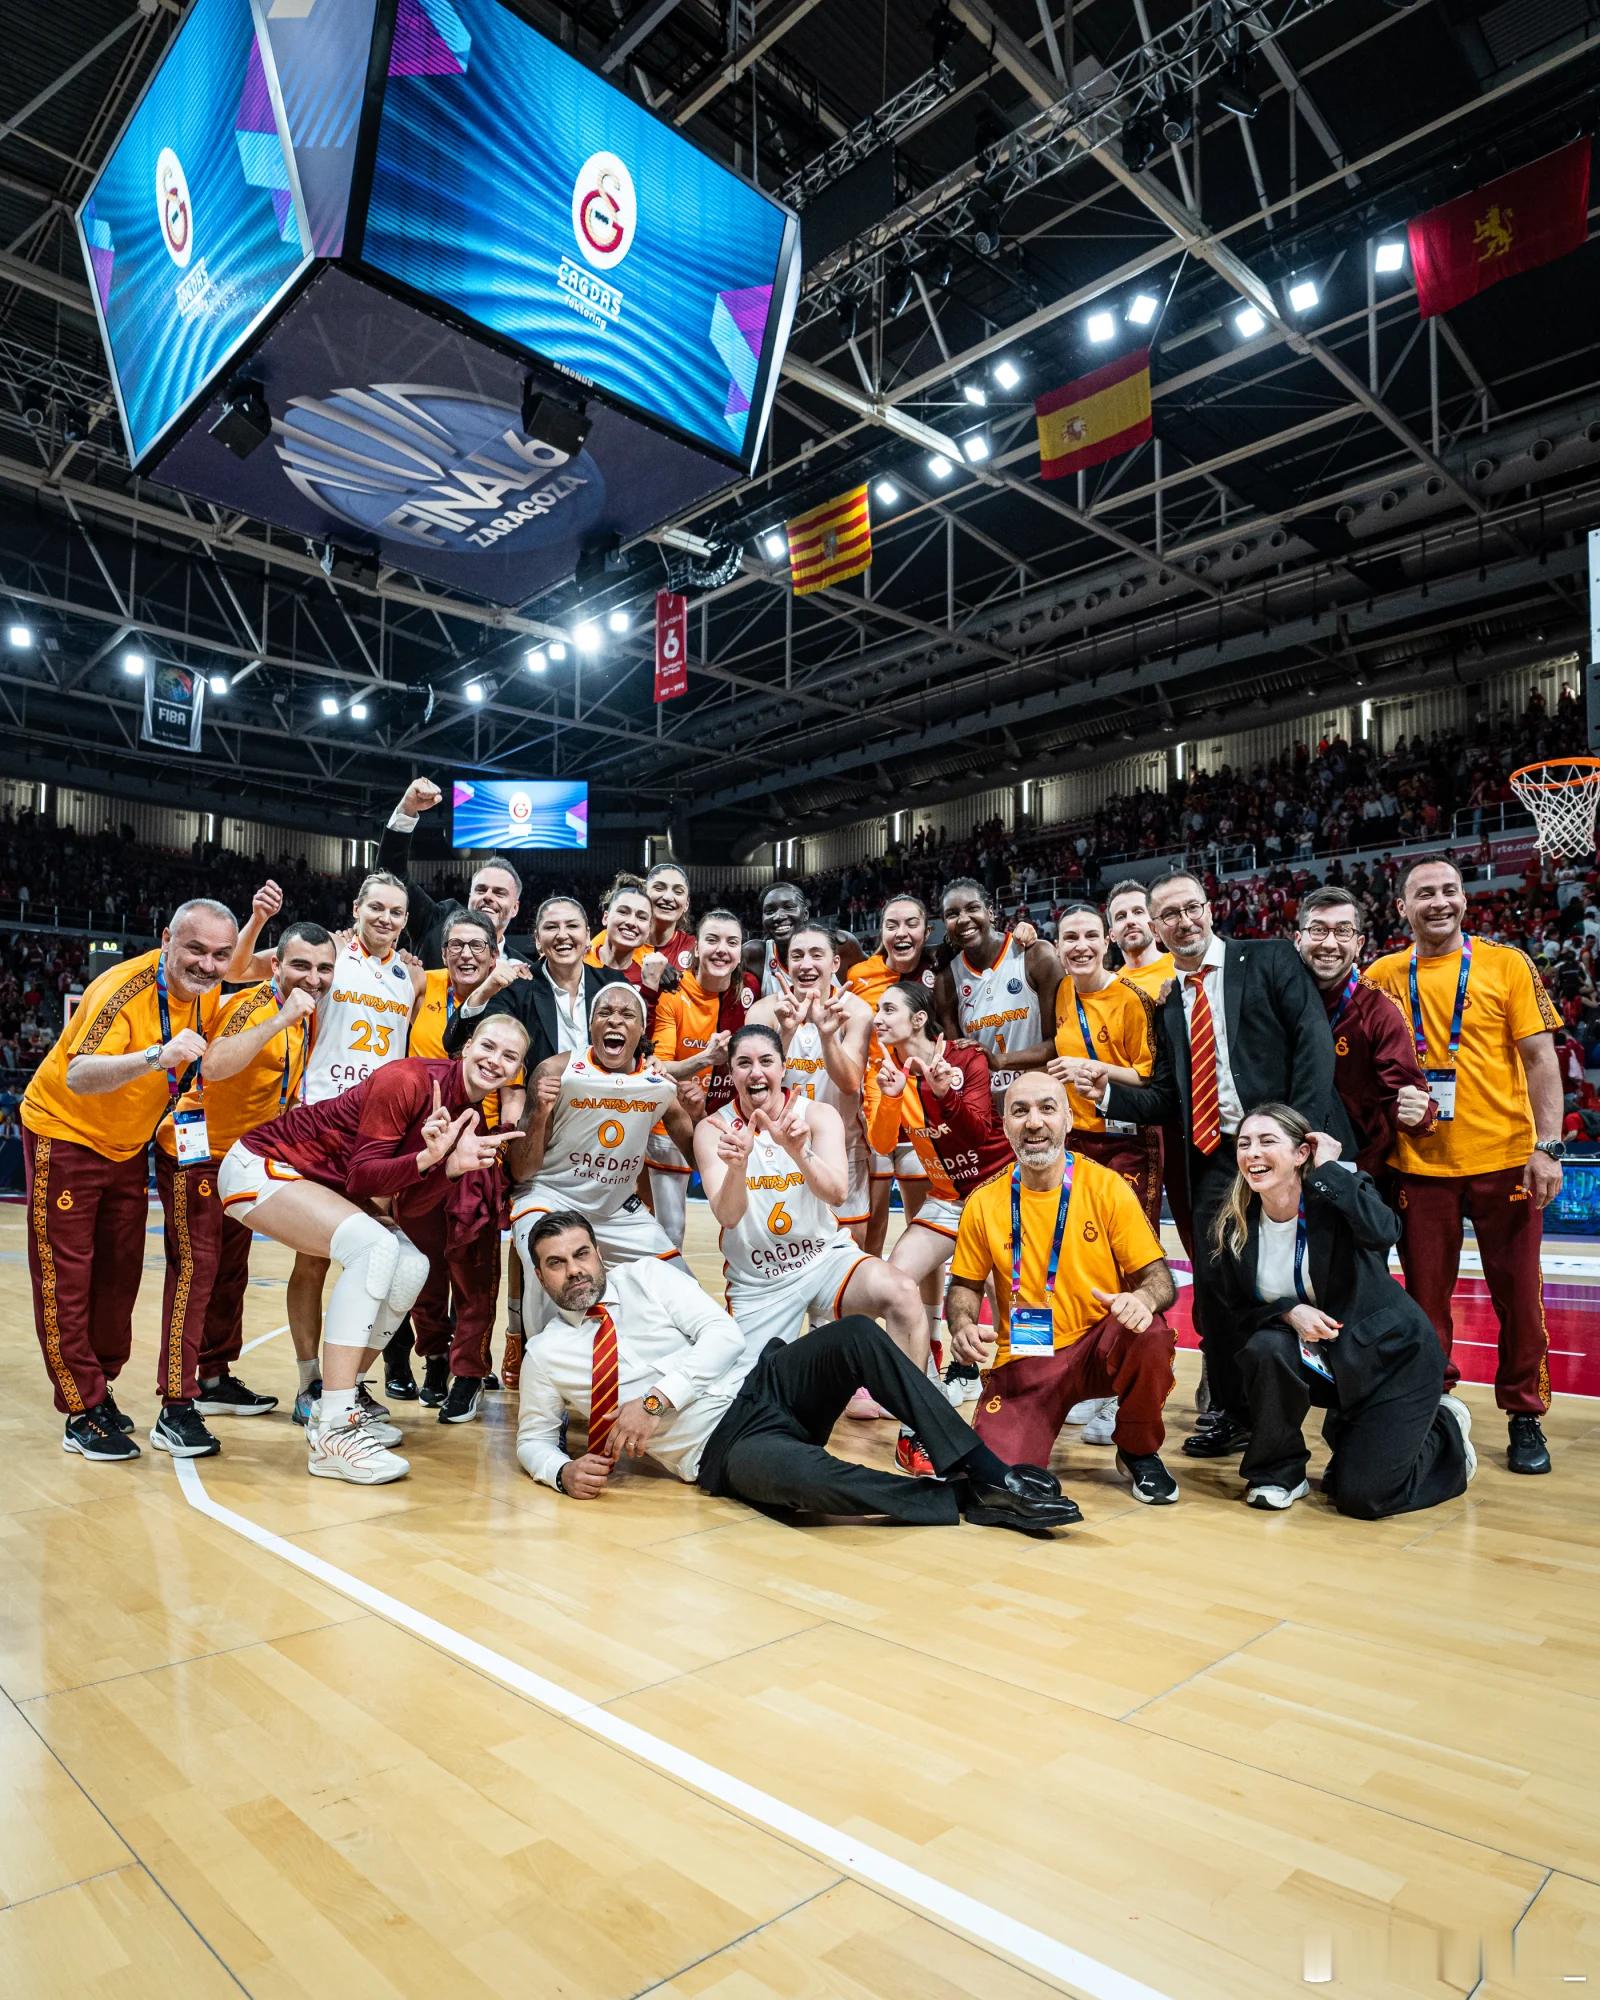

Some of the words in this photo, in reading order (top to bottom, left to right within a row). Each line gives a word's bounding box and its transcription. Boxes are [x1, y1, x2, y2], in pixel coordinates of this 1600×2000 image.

[465, 475, 588, 548] ZARAGOZA
[663, 629, 680, 660] 6
[158, 707, 186, 726] FIBA
[332, 989, 410, 1017] GALATASARAY
[966, 1006, 1030, 1033] GALATASARAY
[348, 1020, 395, 1056] 23
[570, 1097, 662, 1113] GALATASARAY
[597, 1119, 625, 1149] 0
[569, 1151, 640, 1172] ÇAĞDAŞ
[925, 1149, 980, 1171] AĞDAŞ
[573, 1167, 631, 1185] faktoring
[1509, 1193, 1528, 1202] KING
[767, 1201, 793, 1236] 6
[764, 1246, 824, 1279] faktoring
